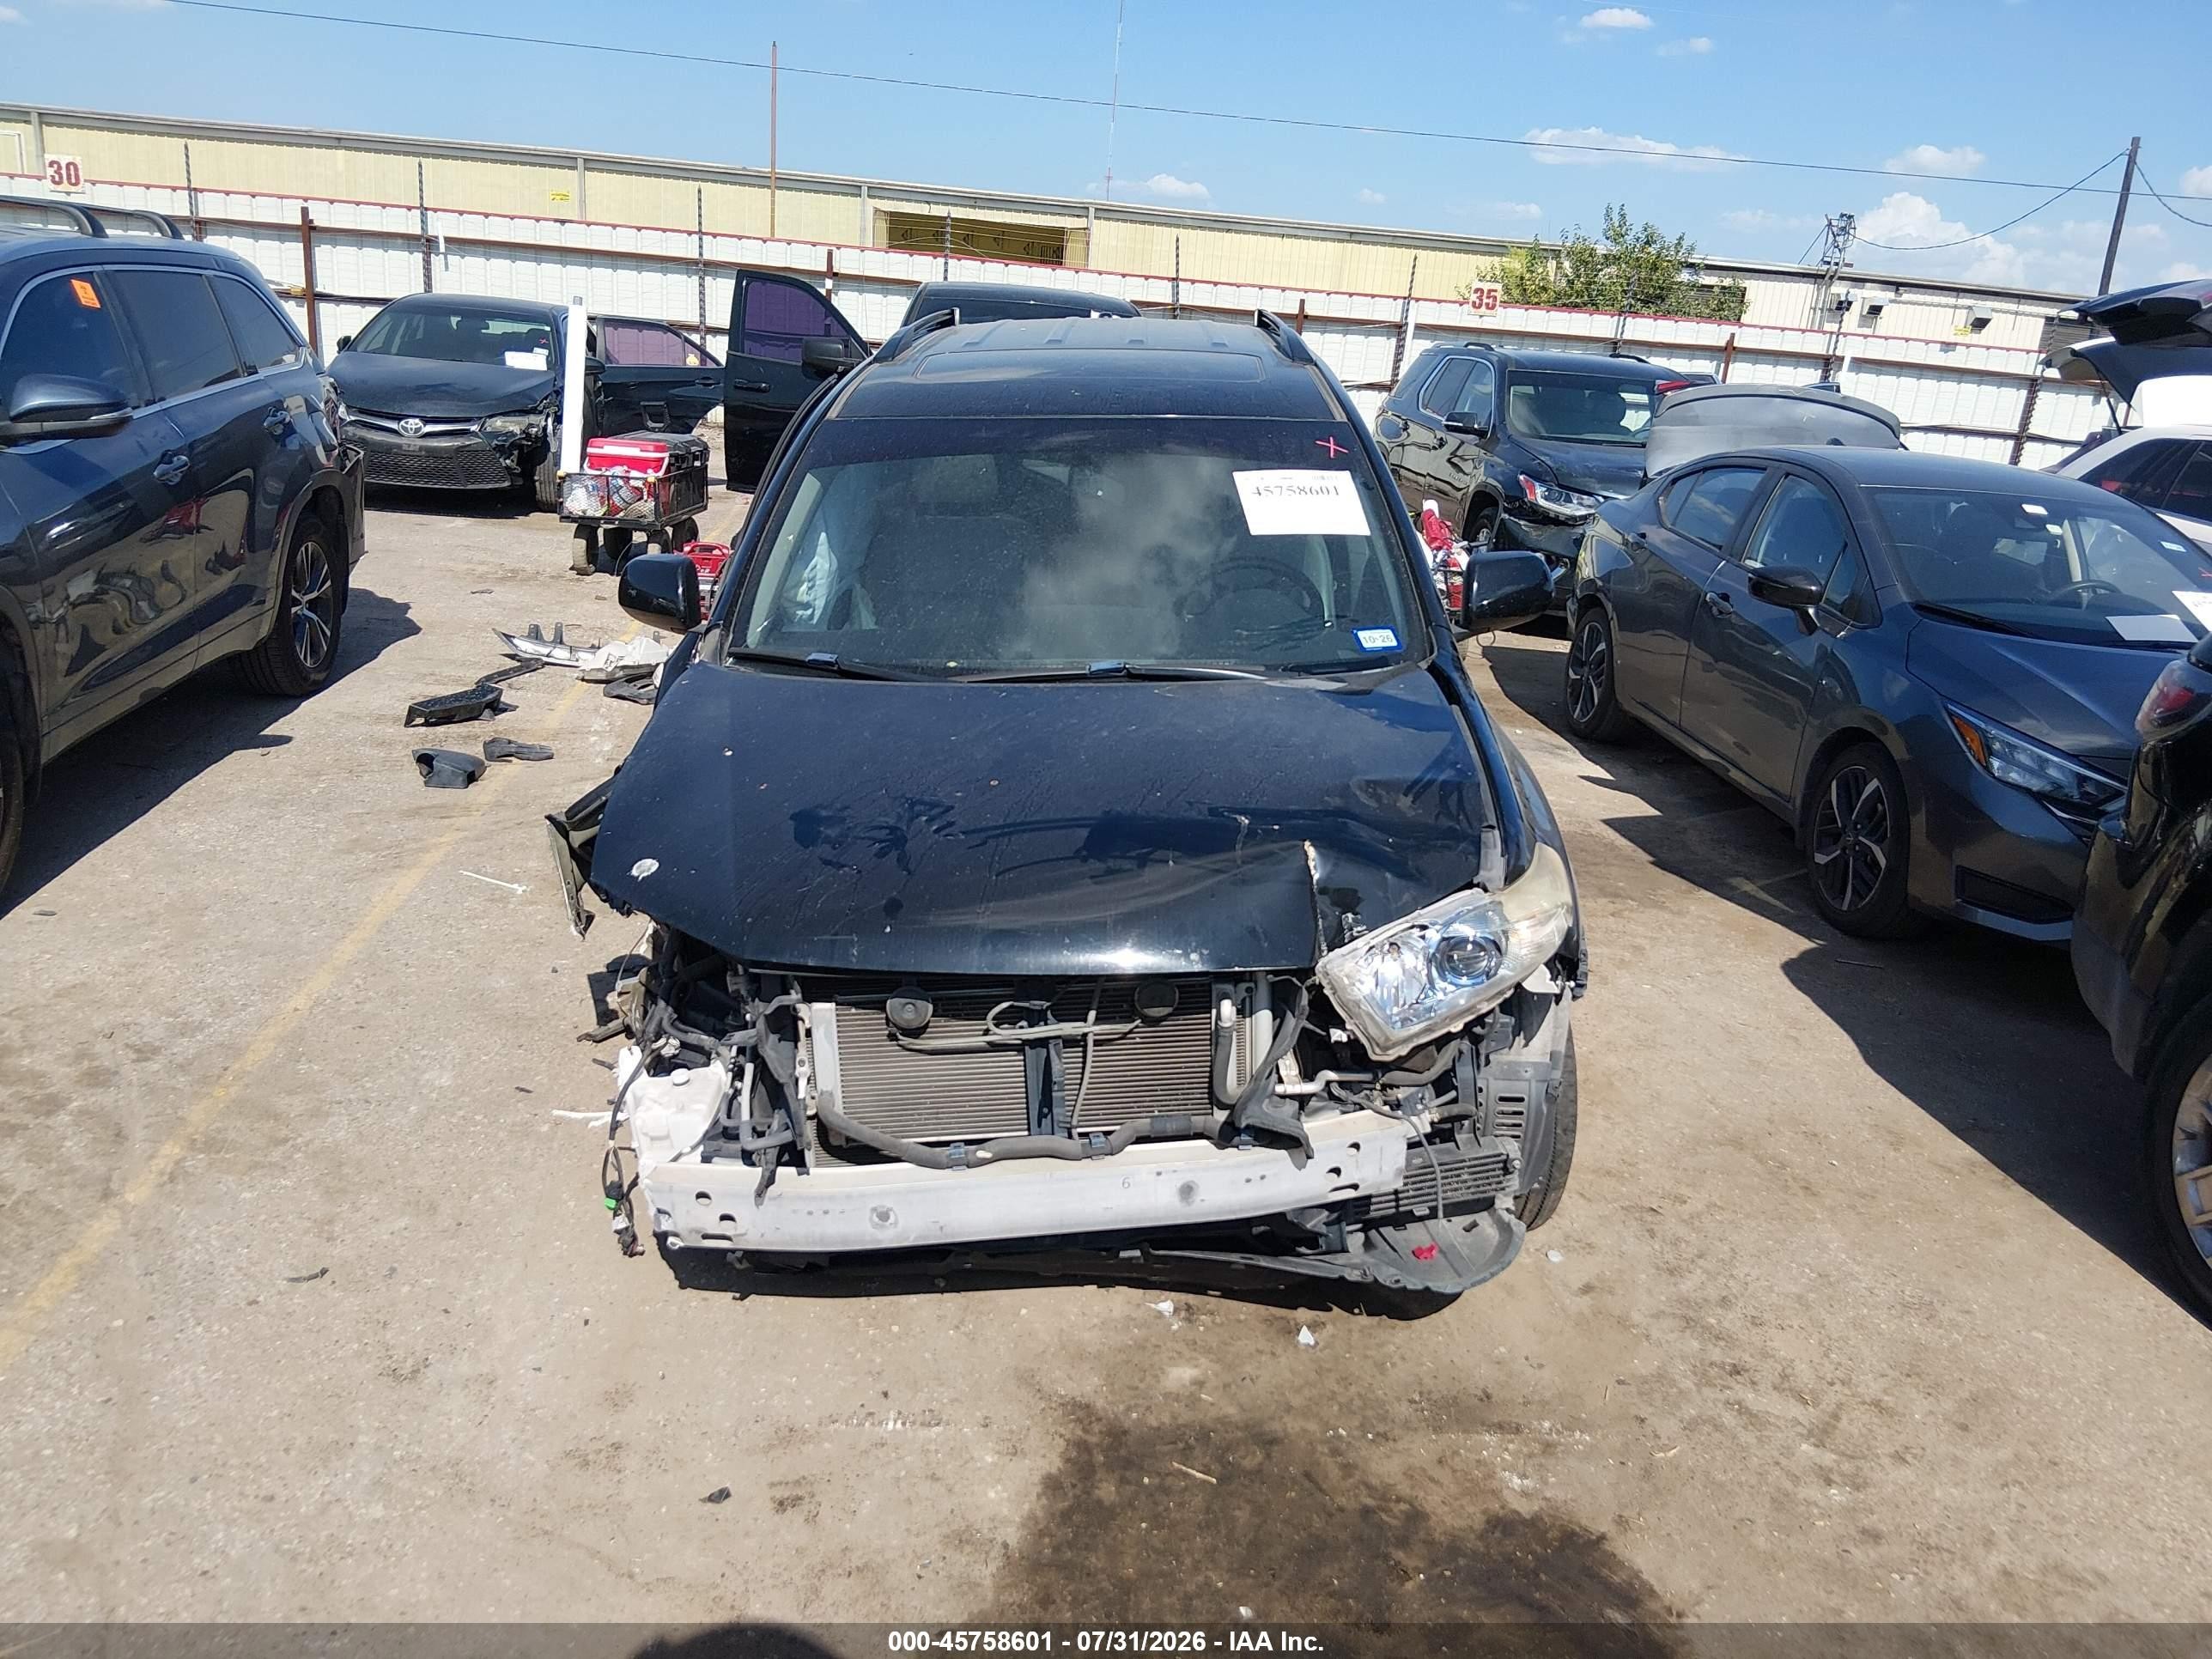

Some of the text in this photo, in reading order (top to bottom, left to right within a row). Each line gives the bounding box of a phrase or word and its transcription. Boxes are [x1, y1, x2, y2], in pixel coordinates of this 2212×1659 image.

[48, 160, 81, 186] 30
[1471, 288, 1498, 310] 35
[1252, 484, 1340, 497] 45758601
